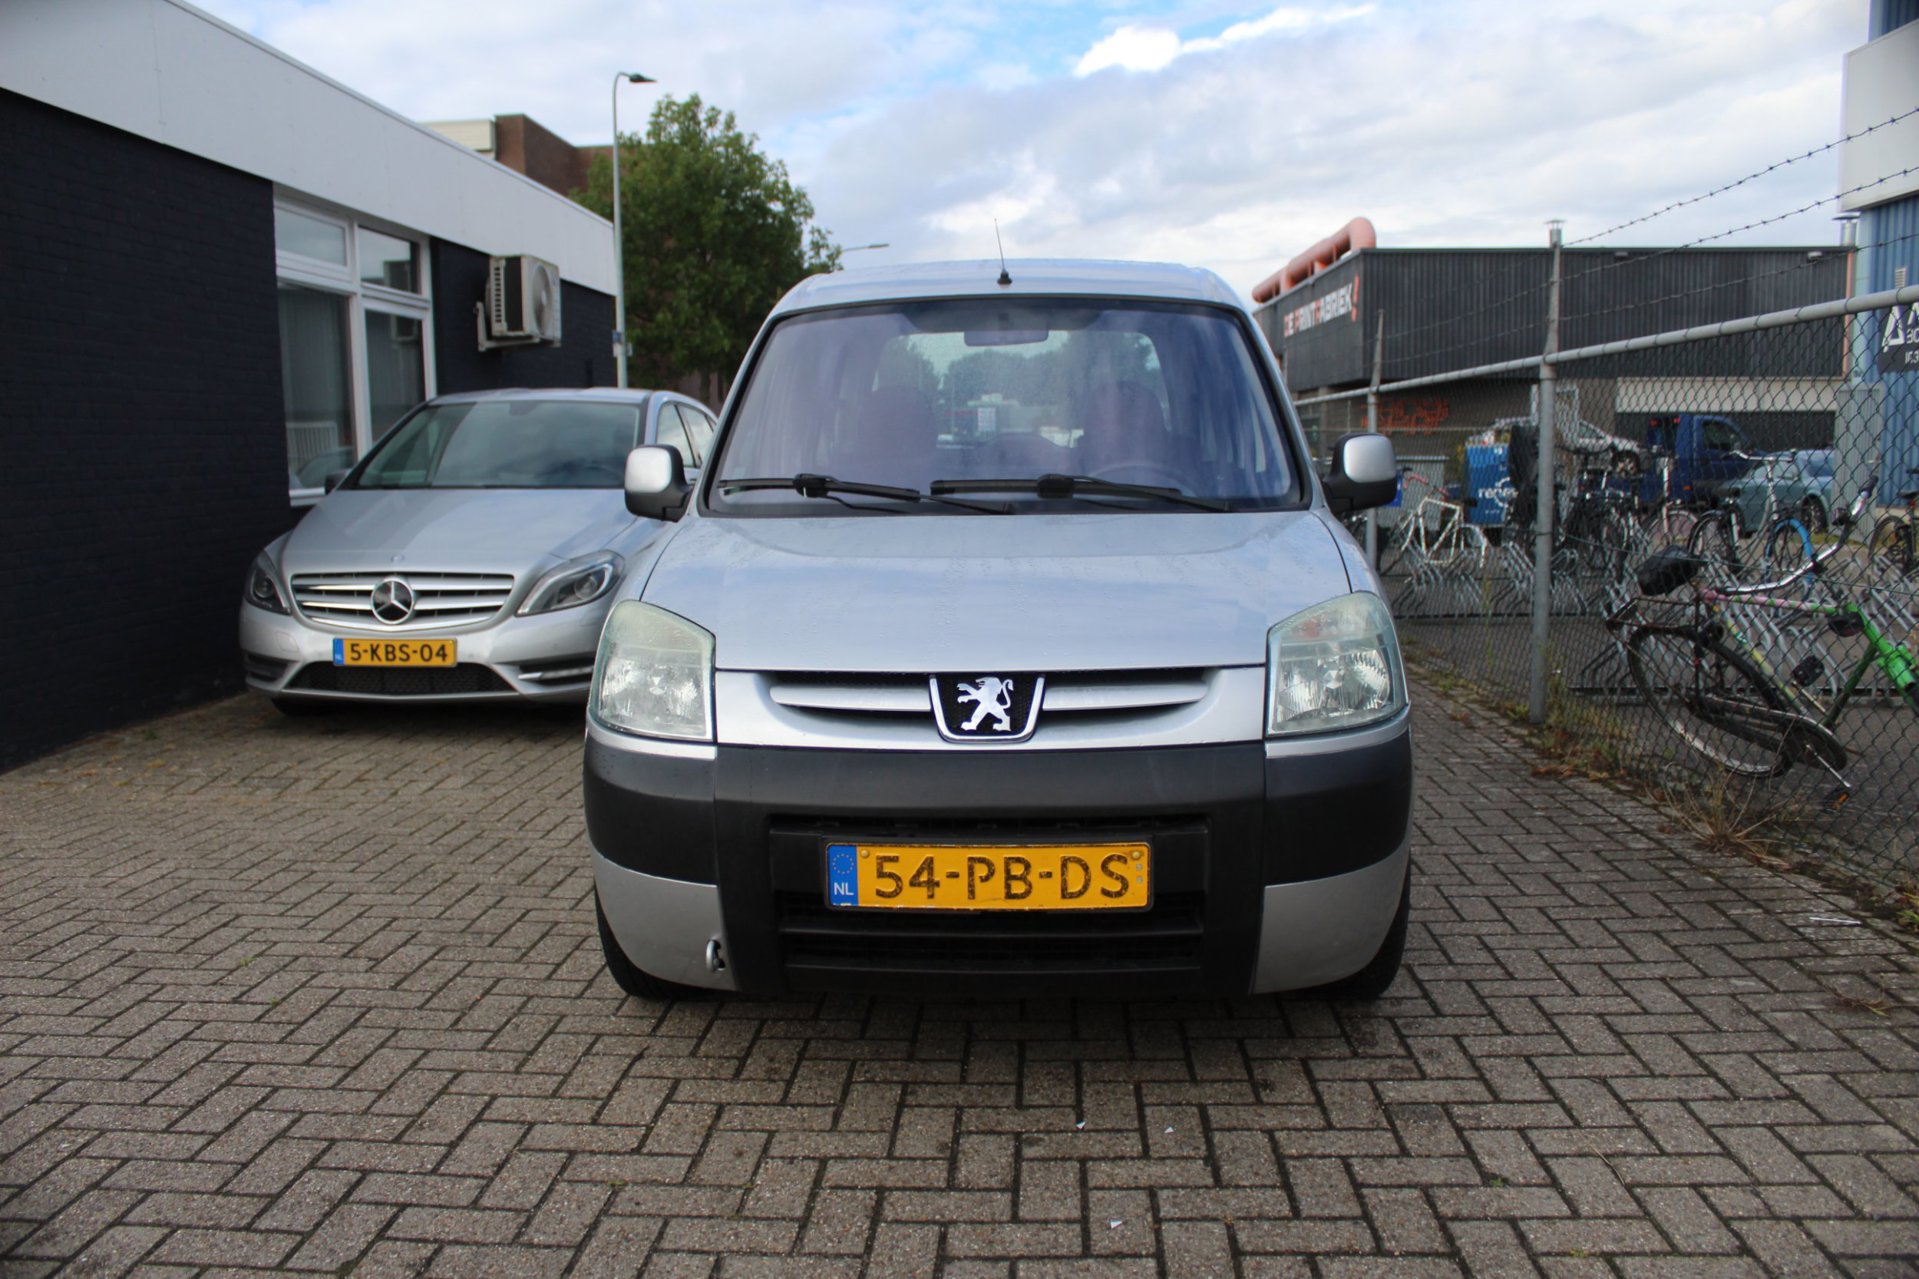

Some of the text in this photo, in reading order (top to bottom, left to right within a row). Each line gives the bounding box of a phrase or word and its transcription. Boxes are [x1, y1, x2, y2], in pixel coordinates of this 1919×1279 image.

[350, 643, 447, 662] 5-KBS-04
[833, 853, 1131, 902] NL 54-PB-DS
